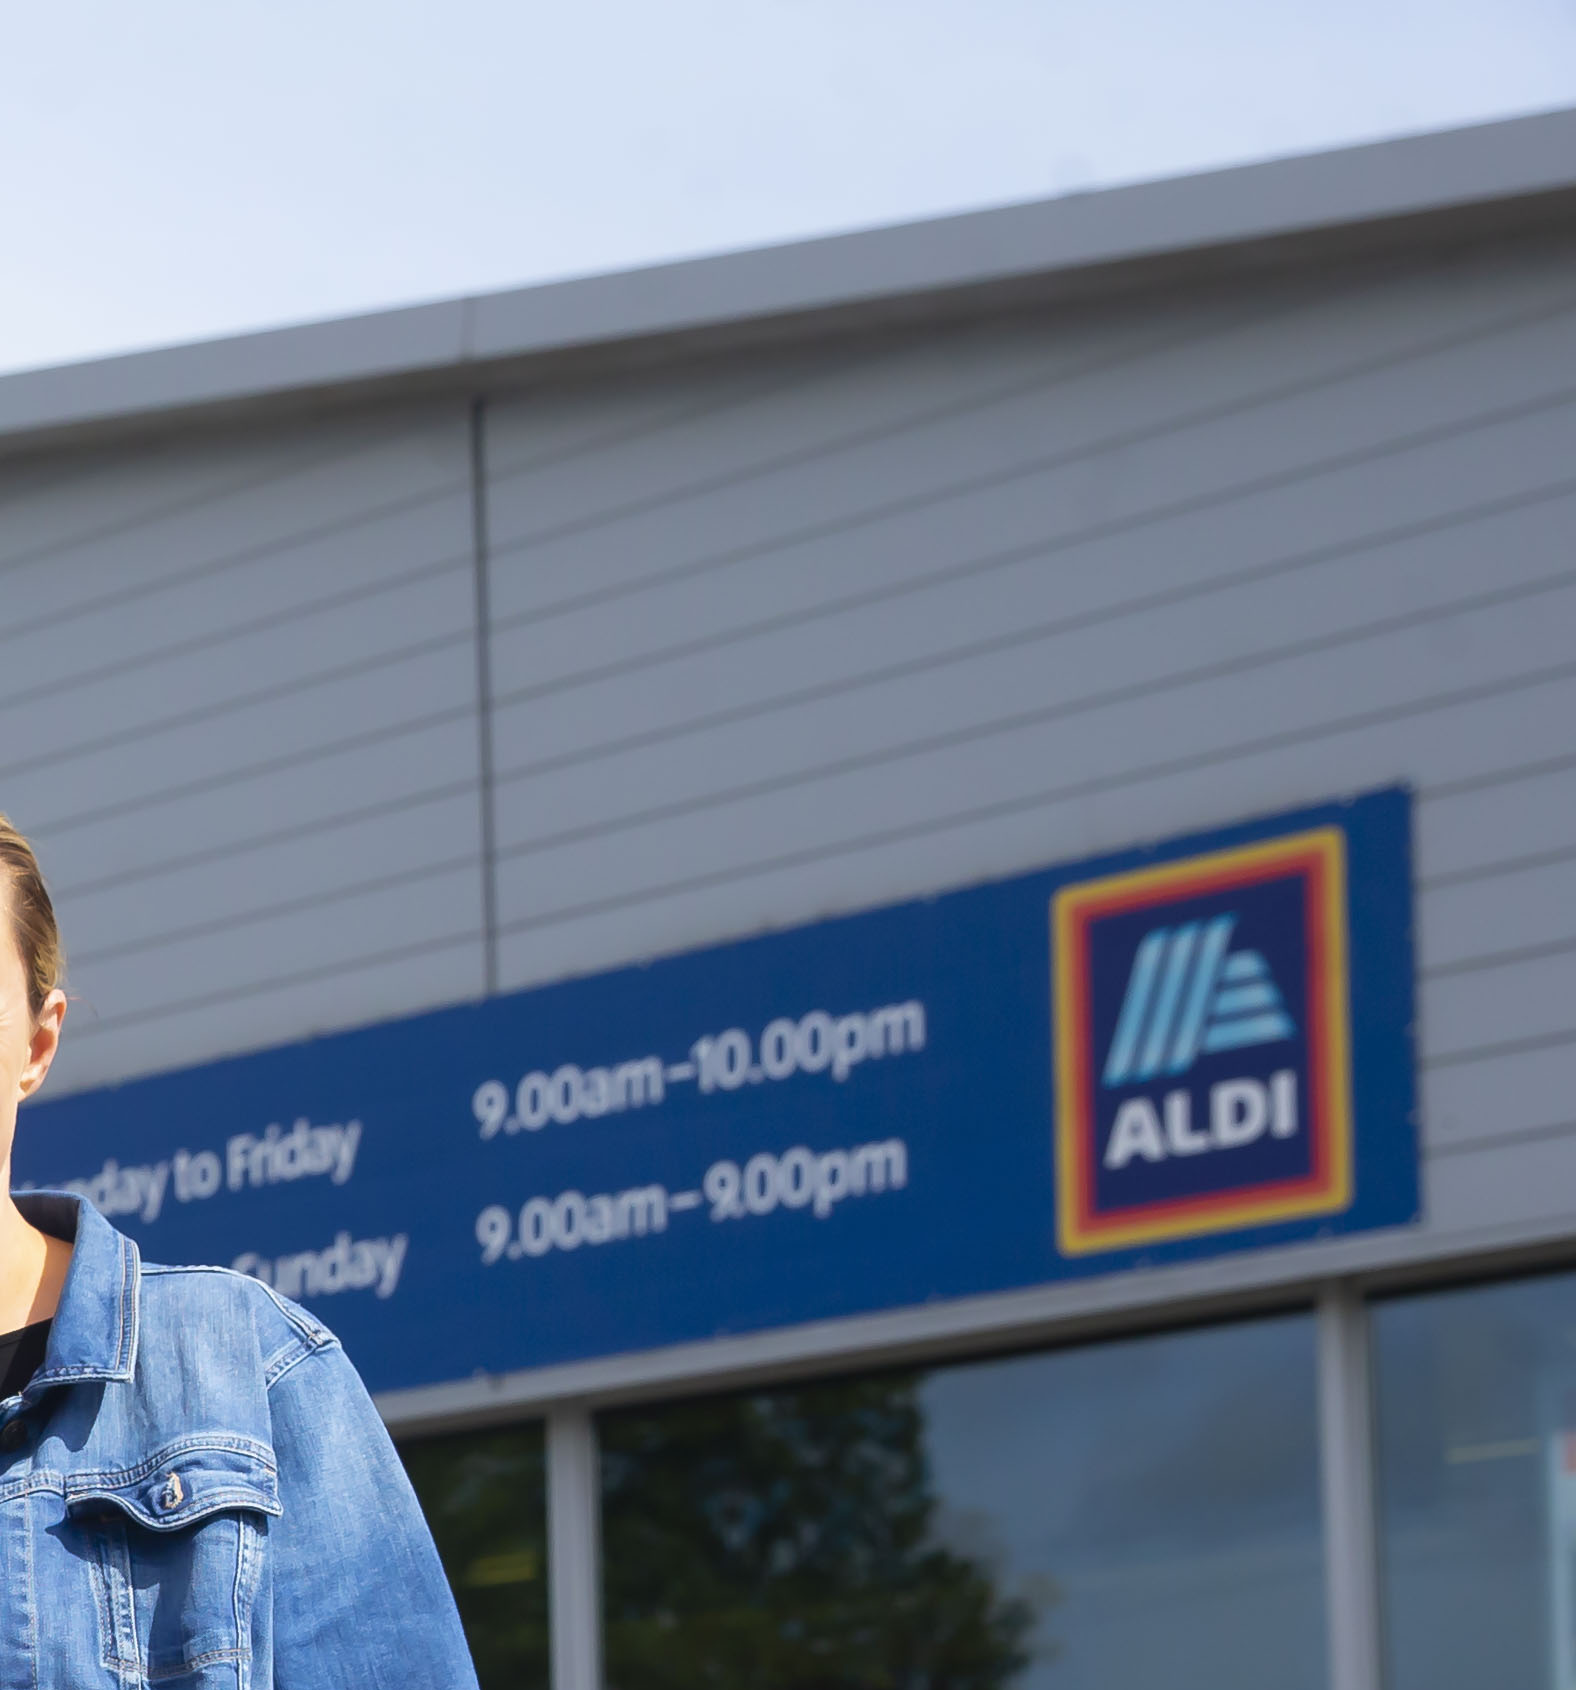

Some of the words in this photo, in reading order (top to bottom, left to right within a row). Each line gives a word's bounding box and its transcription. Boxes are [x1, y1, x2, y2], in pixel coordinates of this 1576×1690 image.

[174, 1148, 222, 1203] to
[227, 1117, 362, 1187] Friday
[1105, 1070, 1297, 1167] ALDI
